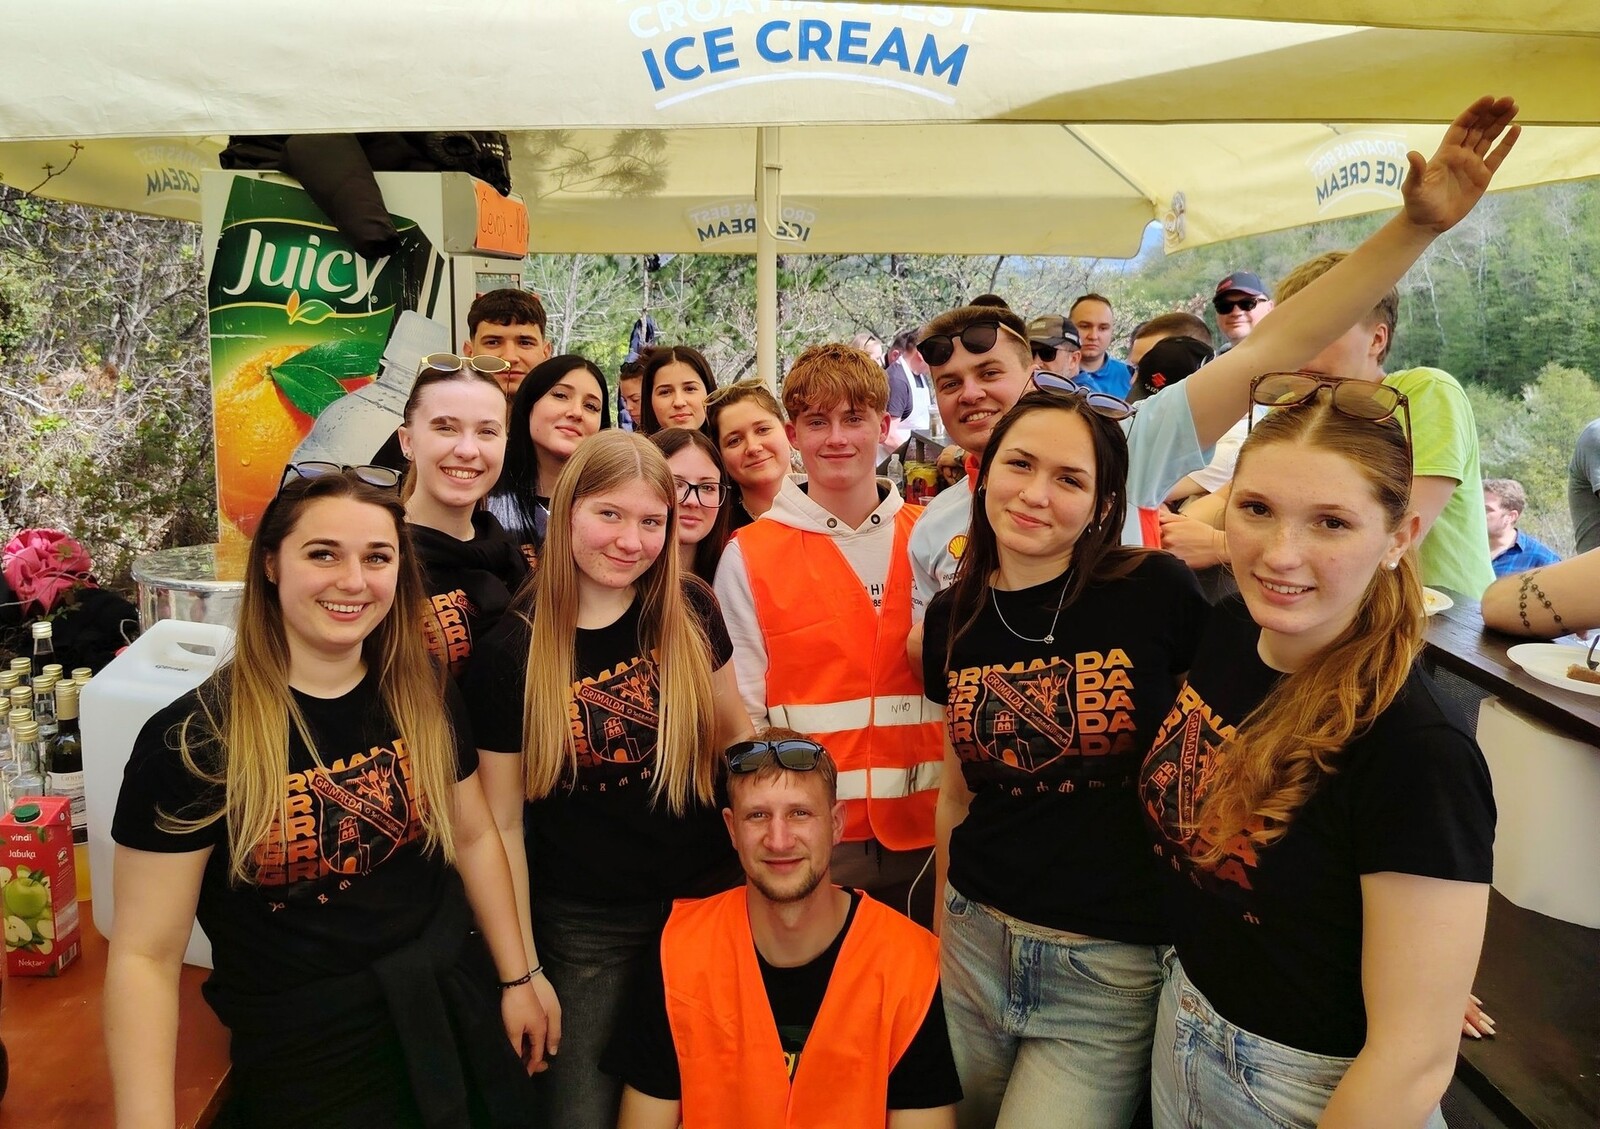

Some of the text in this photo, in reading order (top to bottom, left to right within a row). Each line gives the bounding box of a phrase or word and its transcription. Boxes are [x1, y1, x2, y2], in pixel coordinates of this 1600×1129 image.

[641, 19, 970, 92] ICE CREAM
[222, 228, 391, 304] Juicy
[581, 687, 625, 713] GRIMALDA
[986, 674, 1025, 711] GRIMALDA
[1183, 712, 1199, 773] GRIMALDA
[315, 776, 363, 811] GRIMALDA
[8, 849, 36, 860] Jabuka
[10, 833, 32, 842] vindi
[18, 959, 46, 968] Nektar
